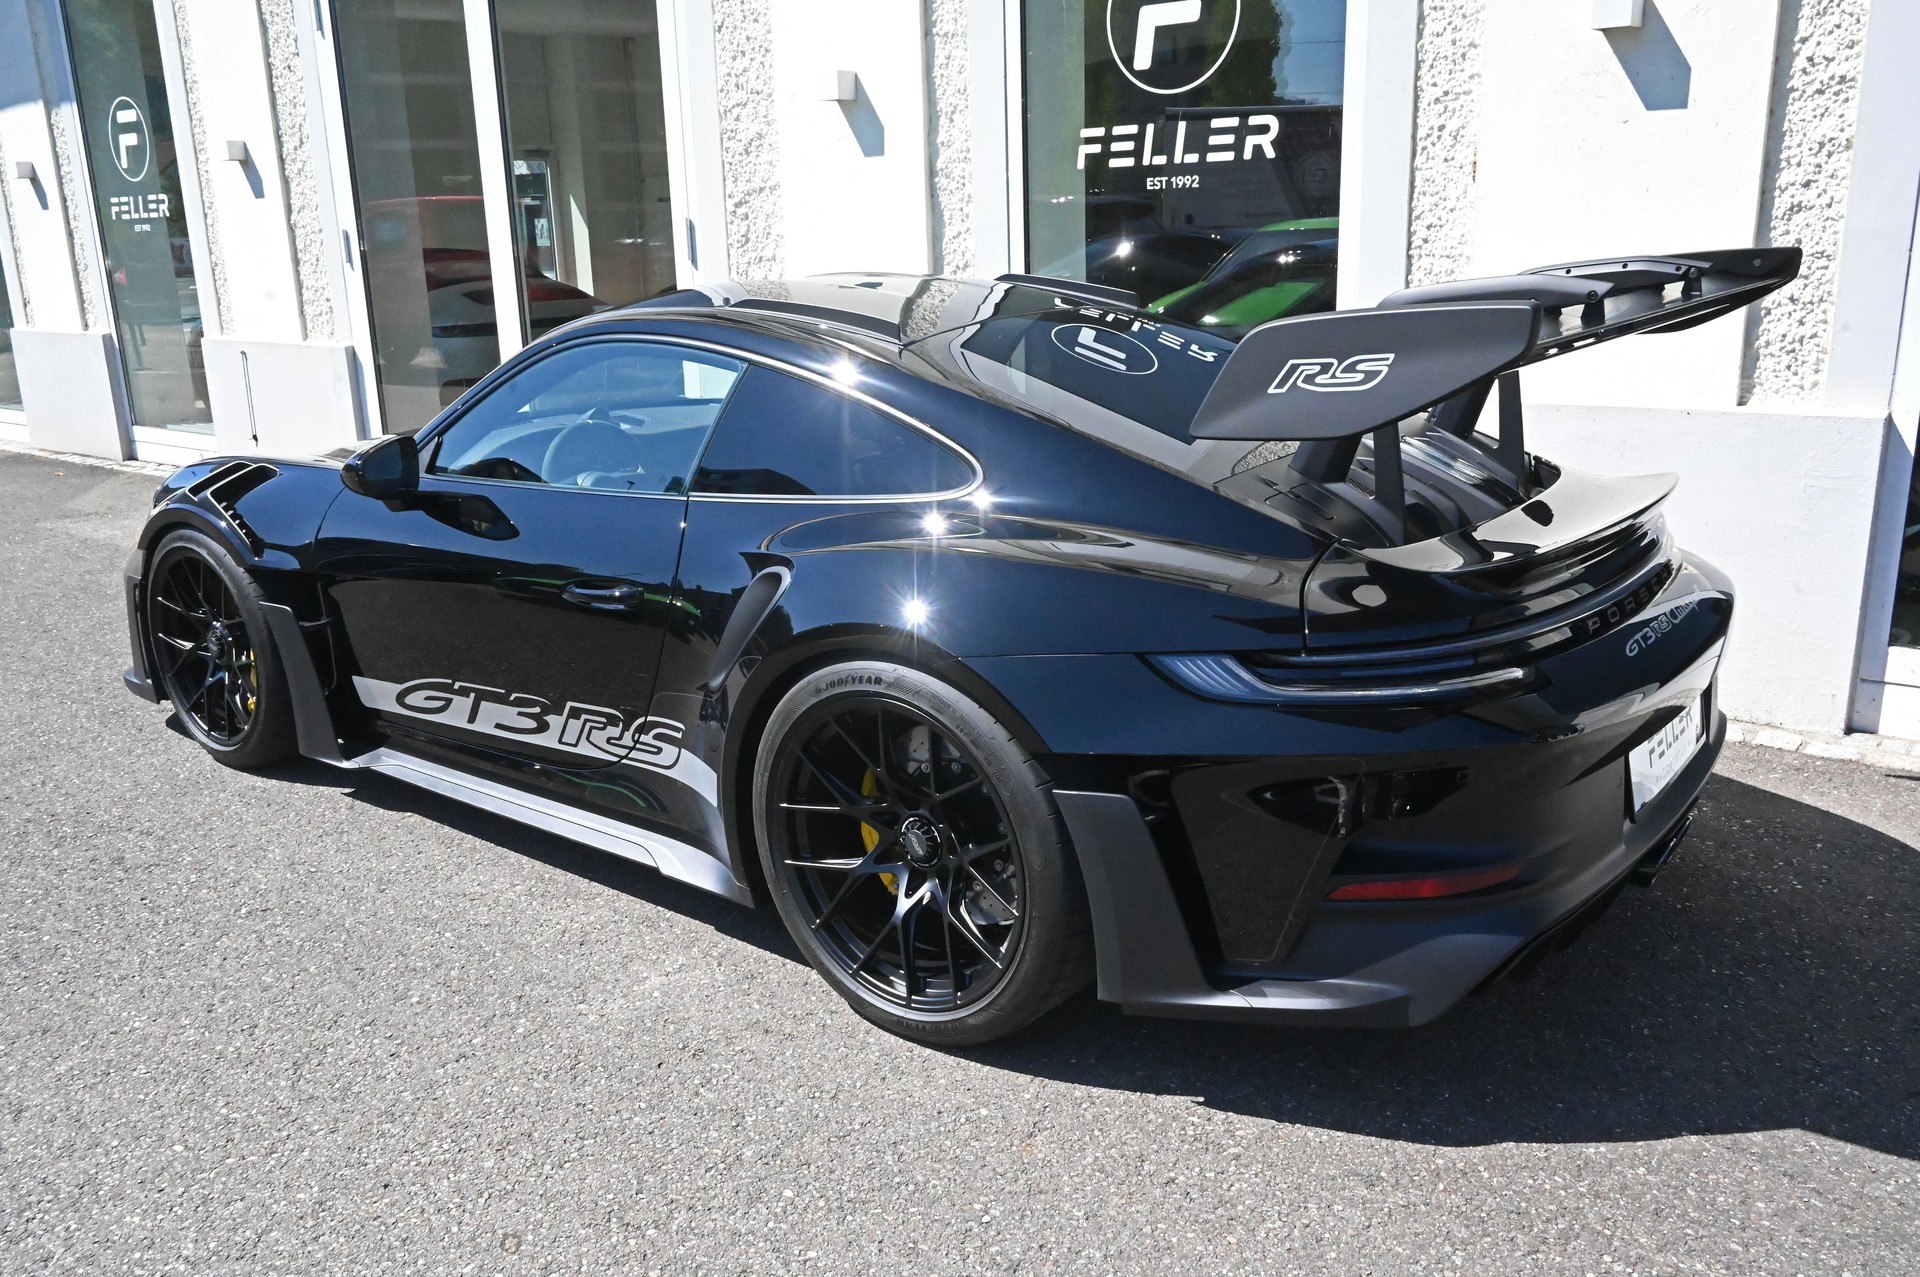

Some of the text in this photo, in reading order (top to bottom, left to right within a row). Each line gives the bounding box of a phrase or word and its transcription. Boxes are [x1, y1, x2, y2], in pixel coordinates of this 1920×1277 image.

[1077, 114, 1280, 170] FELLER
[1146, 174, 1200, 190] EST 1992
[110, 193, 170, 220] FELLER
[1267, 353, 1395, 394] RS
